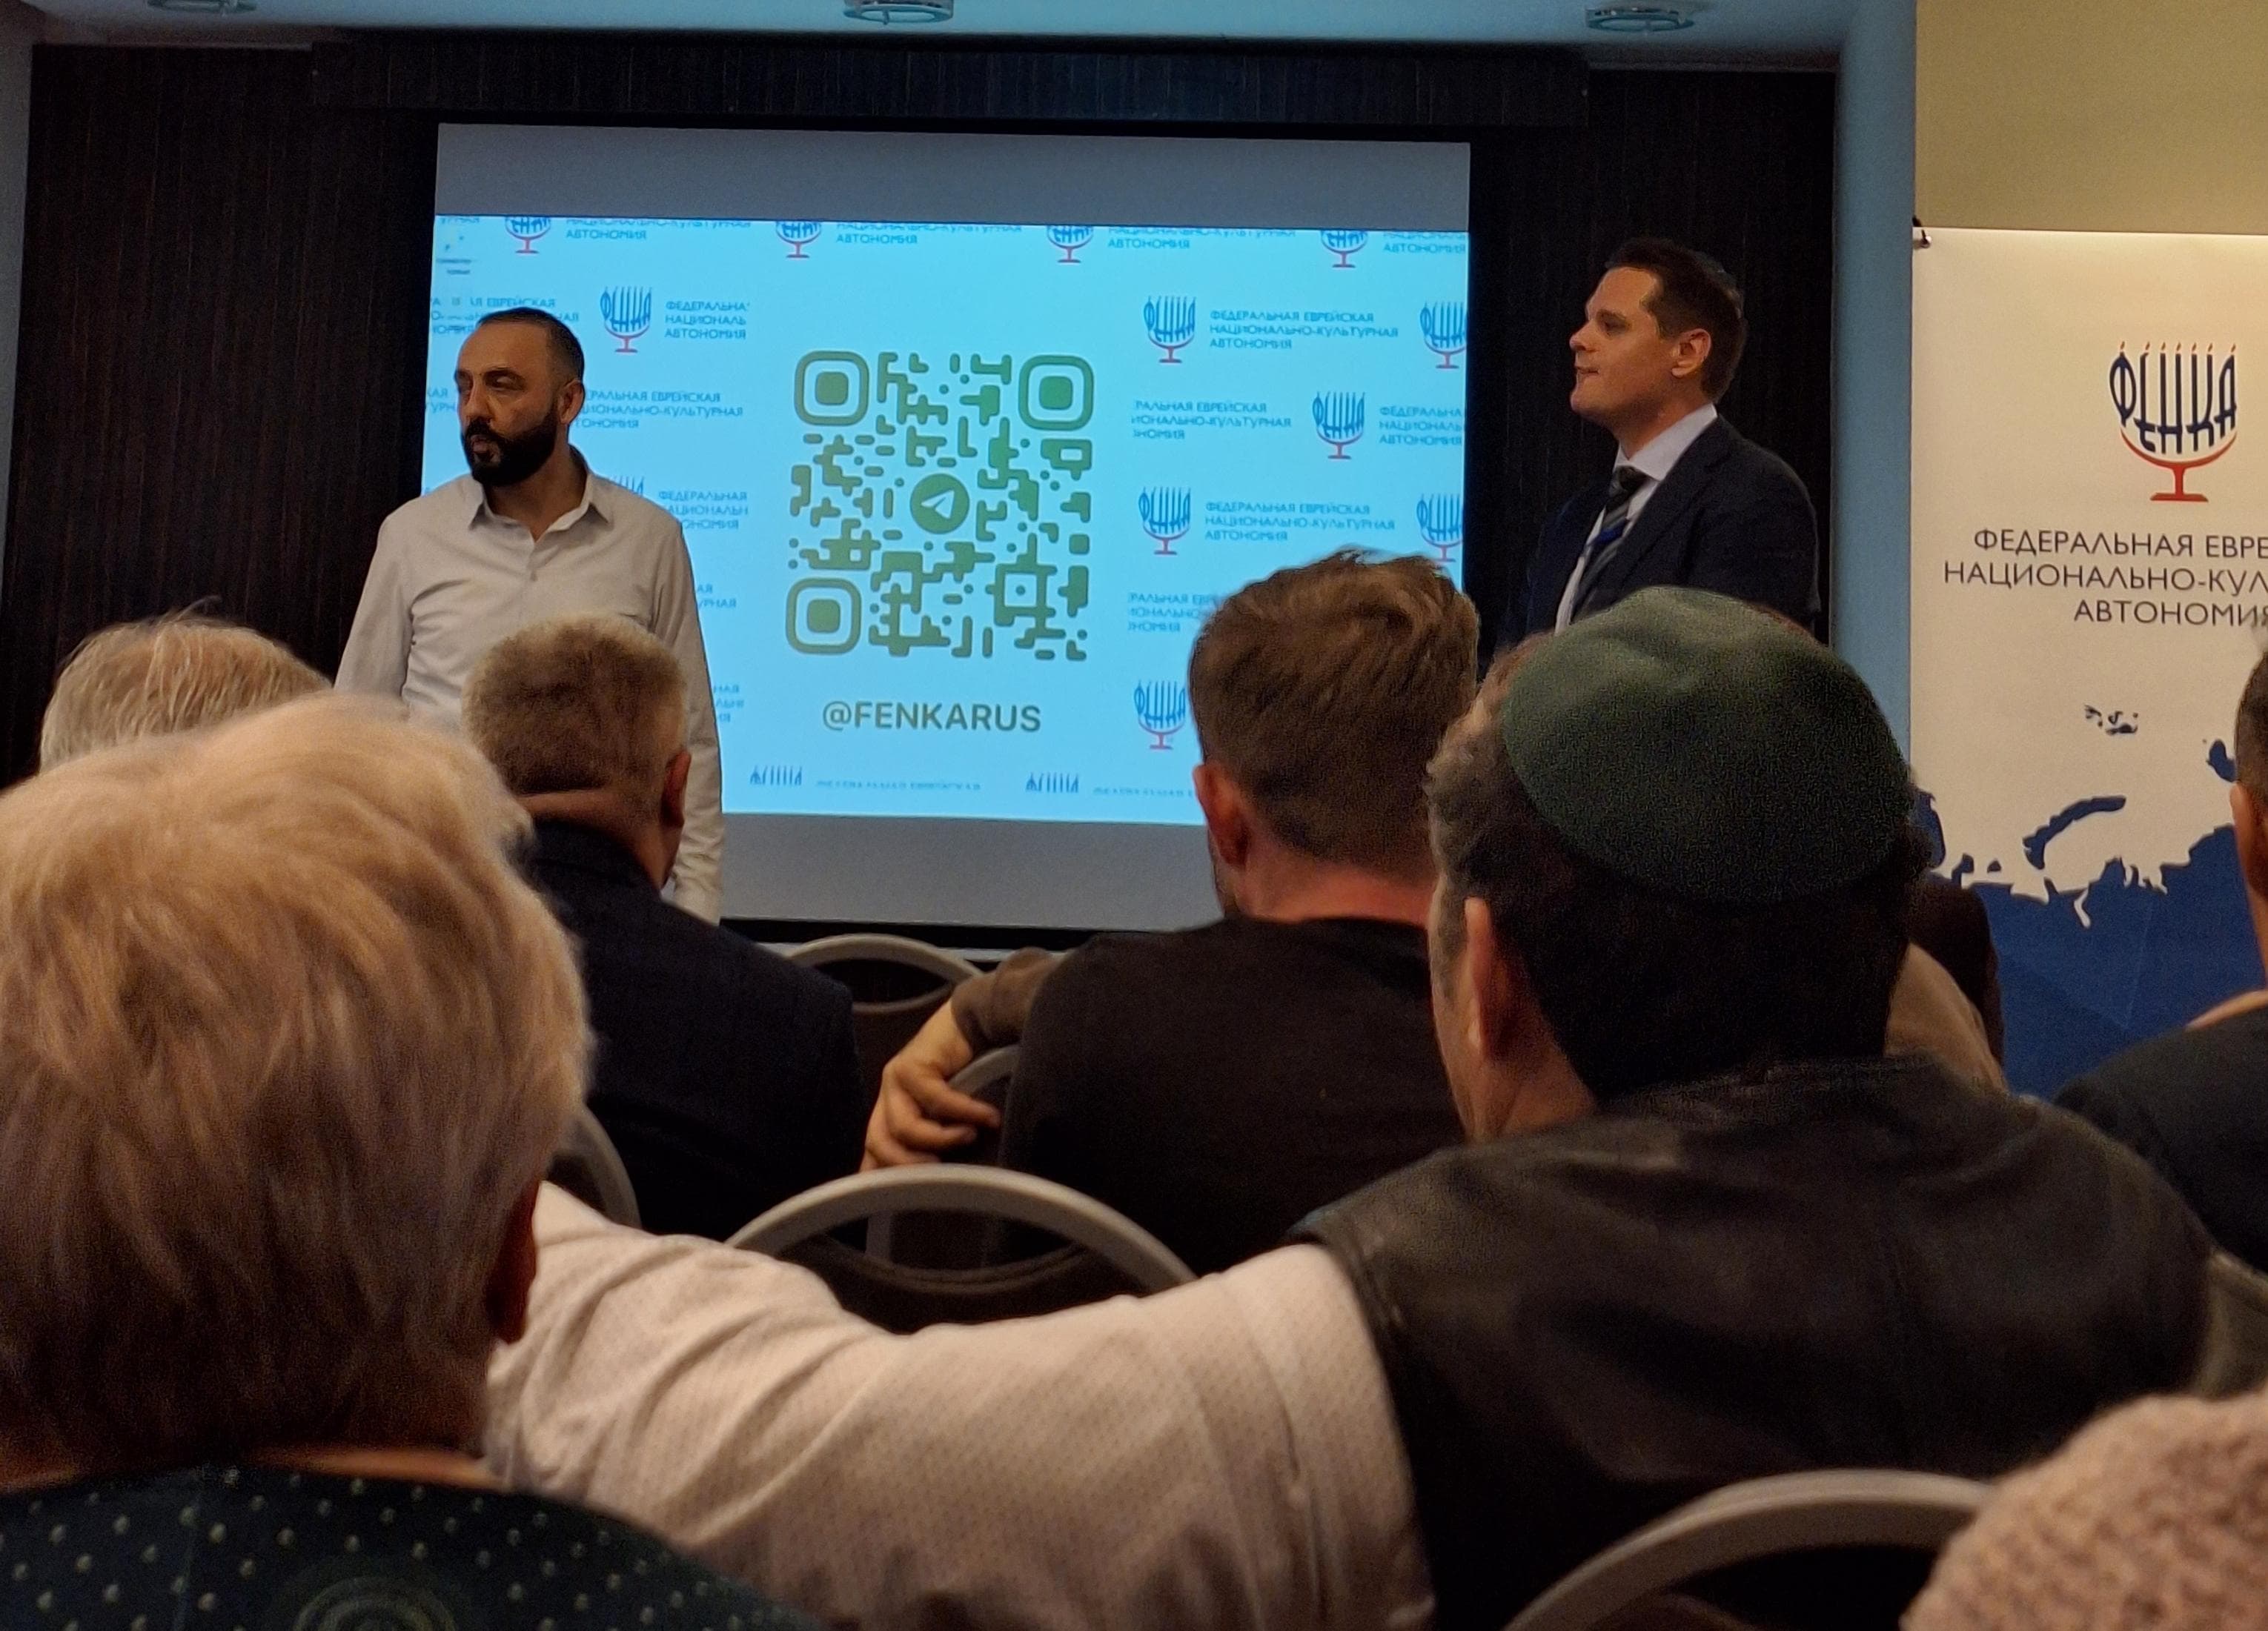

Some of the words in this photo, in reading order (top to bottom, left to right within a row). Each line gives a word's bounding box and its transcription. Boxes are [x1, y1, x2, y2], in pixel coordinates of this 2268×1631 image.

[666, 301, 750, 312] ФЕДЕРАЛЬНА
[1973, 529, 2194, 557] ФЕДЕРАЛЬНАЯ
[1943, 561, 2268, 597] НАЦИОНАЛЬНО-КУЛ
[823, 700, 1042, 732] @FENKARUS
